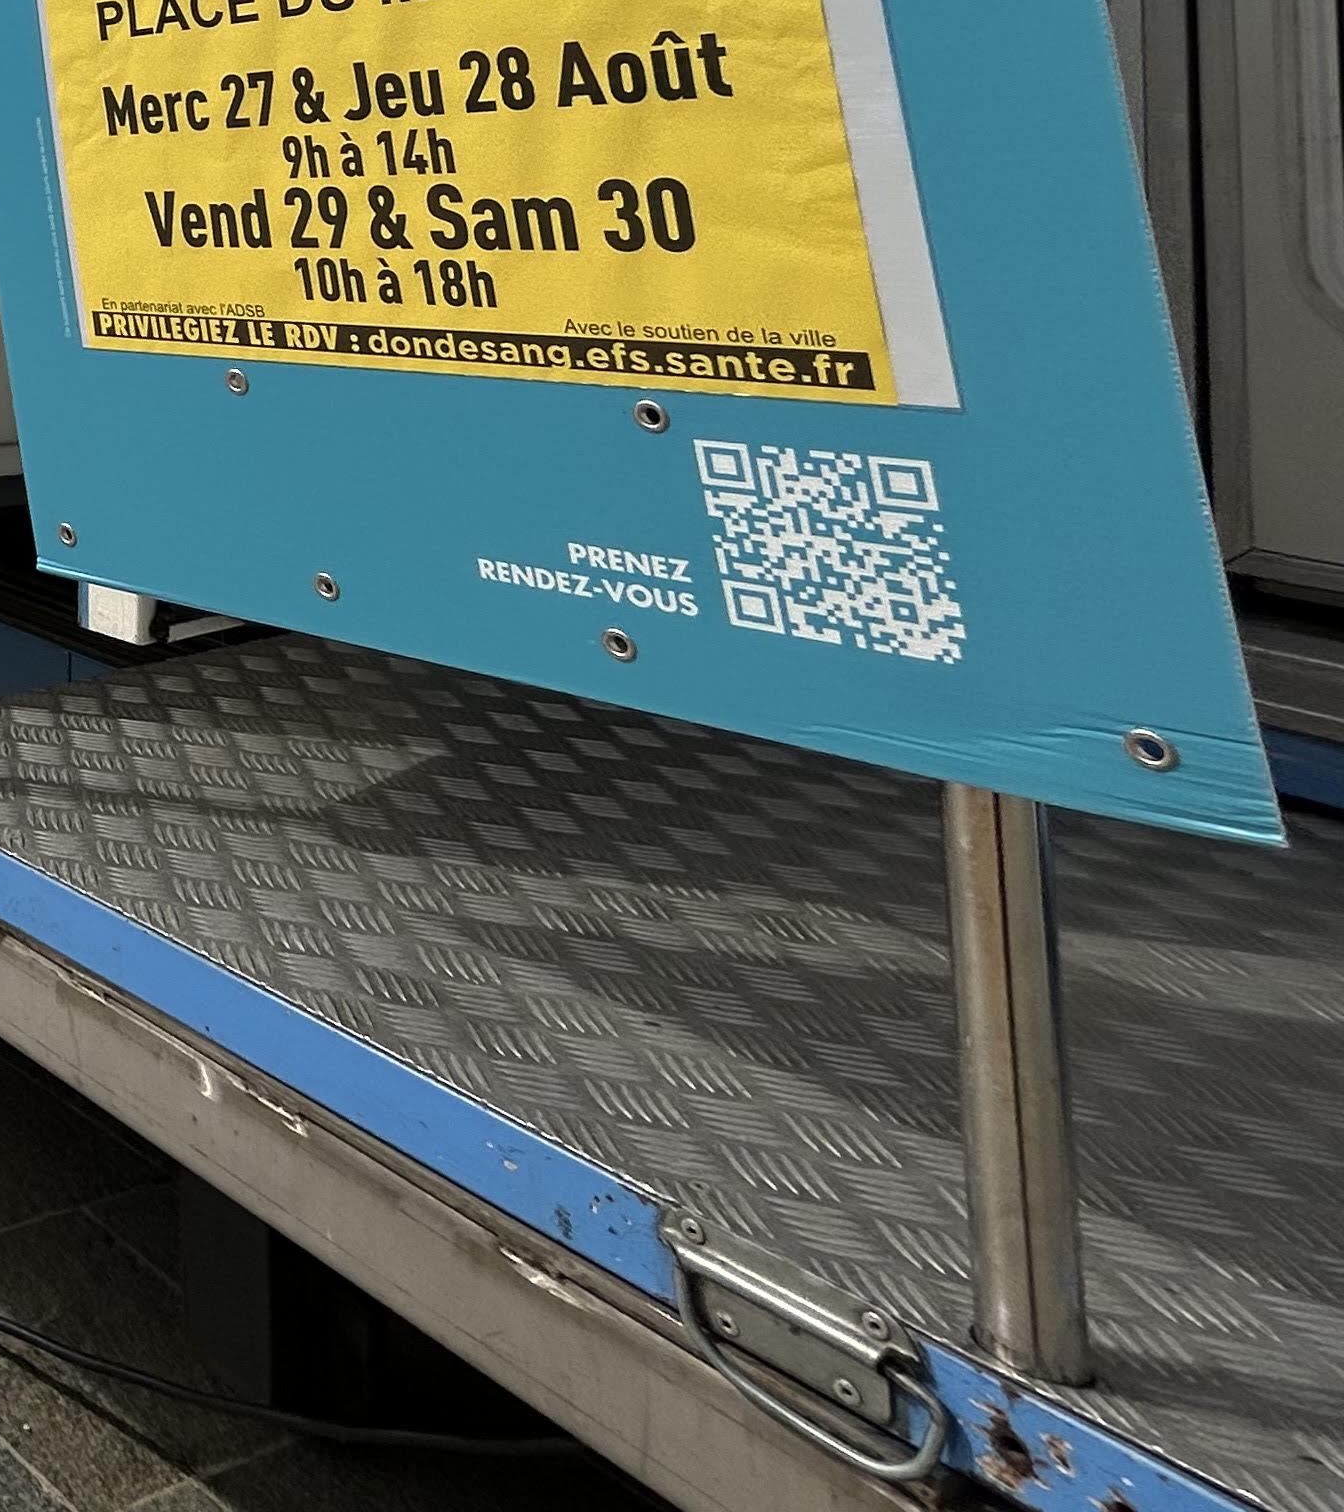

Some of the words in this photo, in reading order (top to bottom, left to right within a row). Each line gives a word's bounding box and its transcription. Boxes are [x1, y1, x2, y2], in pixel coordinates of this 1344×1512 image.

[103, 84, 210, 136] Merc
[220, 70, 275, 129] 27
[294, 68, 329, 124] &
[344, 61, 445, 121] Jeu
[460, 46, 536, 113] 28
[557, 31, 735, 108] Août
[282, 134, 328, 179] 9h
[342, 131, 364, 178] à
[376, 127, 457, 176] 14h
[144, 188, 272, 249] Vend
[284, 184, 348, 249] 29
[368, 185, 414, 250] &
[427, 183, 579, 252] Sam
[598, 177, 697, 253] 30
[101, 298, 117, 310] En
[120, 300, 184, 315] partenariat
[186, 305, 217, 316] avec
[219, 303, 265, 318] l'ADSB
[293, 257, 365, 302] 10h
[377, 258, 403, 305] à
[413, 259, 499, 308] 18h
[98, 313, 239, 344] PRIVILEGIEZ
[247, 321, 275, 346] LE
[286, 323, 338, 350] RDV
[368, 329, 856, 385] dondesang.efs.sante.fr
[564, 318, 612, 337] Avec
[618, 321, 636, 338] le
[643, 323, 720, 342] soutien
[726, 327, 754, 344] de
[761, 328, 783, 345] la
[790, 330, 836, 348] ville
[477, 558, 699, 616] RENDEZ-VOUS
[567, 542, 693, 583] PRENEZ
